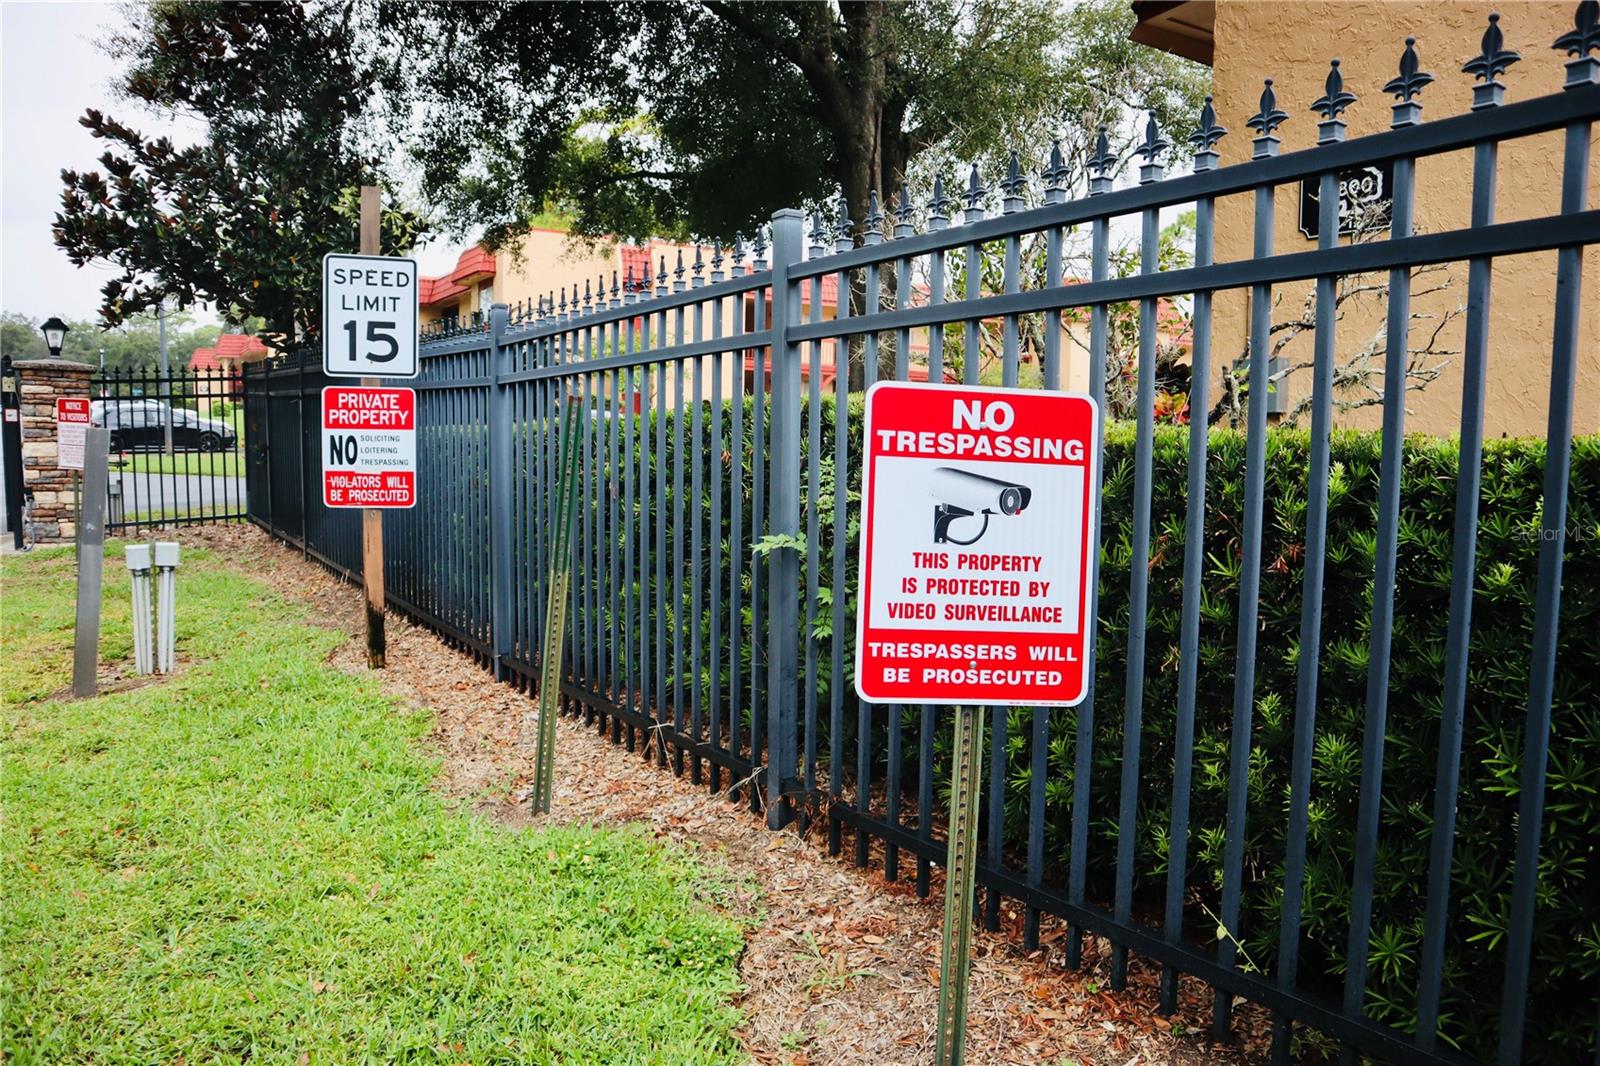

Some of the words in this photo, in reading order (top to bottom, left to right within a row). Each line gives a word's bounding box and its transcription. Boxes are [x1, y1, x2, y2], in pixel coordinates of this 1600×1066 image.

[334, 268, 410, 288] SPEED
[342, 294, 401, 312] LIMIT
[343, 319, 399, 363] 15
[65, 401, 82, 411] NOTICE
[338, 393, 400, 409] PRIVATE
[60, 412, 67, 421] TO
[67, 412, 88, 422] VISITORS
[329, 409, 409, 425] PROPERTY
[952, 399, 1015, 432] NO
[360, 434, 401, 442] SOLICITING
[876, 429, 1084, 461] TRESPASSING
[329, 434, 358, 465] NO
[330, 475, 381, 488] VIOLATORS
[387, 476, 409, 488] WILL
[330, 489, 343, 501] BE
[349, 489, 409, 502] PROSECUTED
[912, 552, 949, 569] THIS
[957, 554, 1042, 573] PROPERTY
[902, 577, 917, 594] IS
[926, 578, 1020, 597] PROTECTED
[1028, 581, 1050, 598] BY
[887, 602, 936, 620] VIDEO
[944, 604, 1062, 623] SURVEILLANCE
[868, 642, 1017, 660] TRESPASSERS
[1028, 646, 1077, 662] WILL
[883, 667, 910, 683] BE
[922, 668, 1062, 686] PROSECUTED
